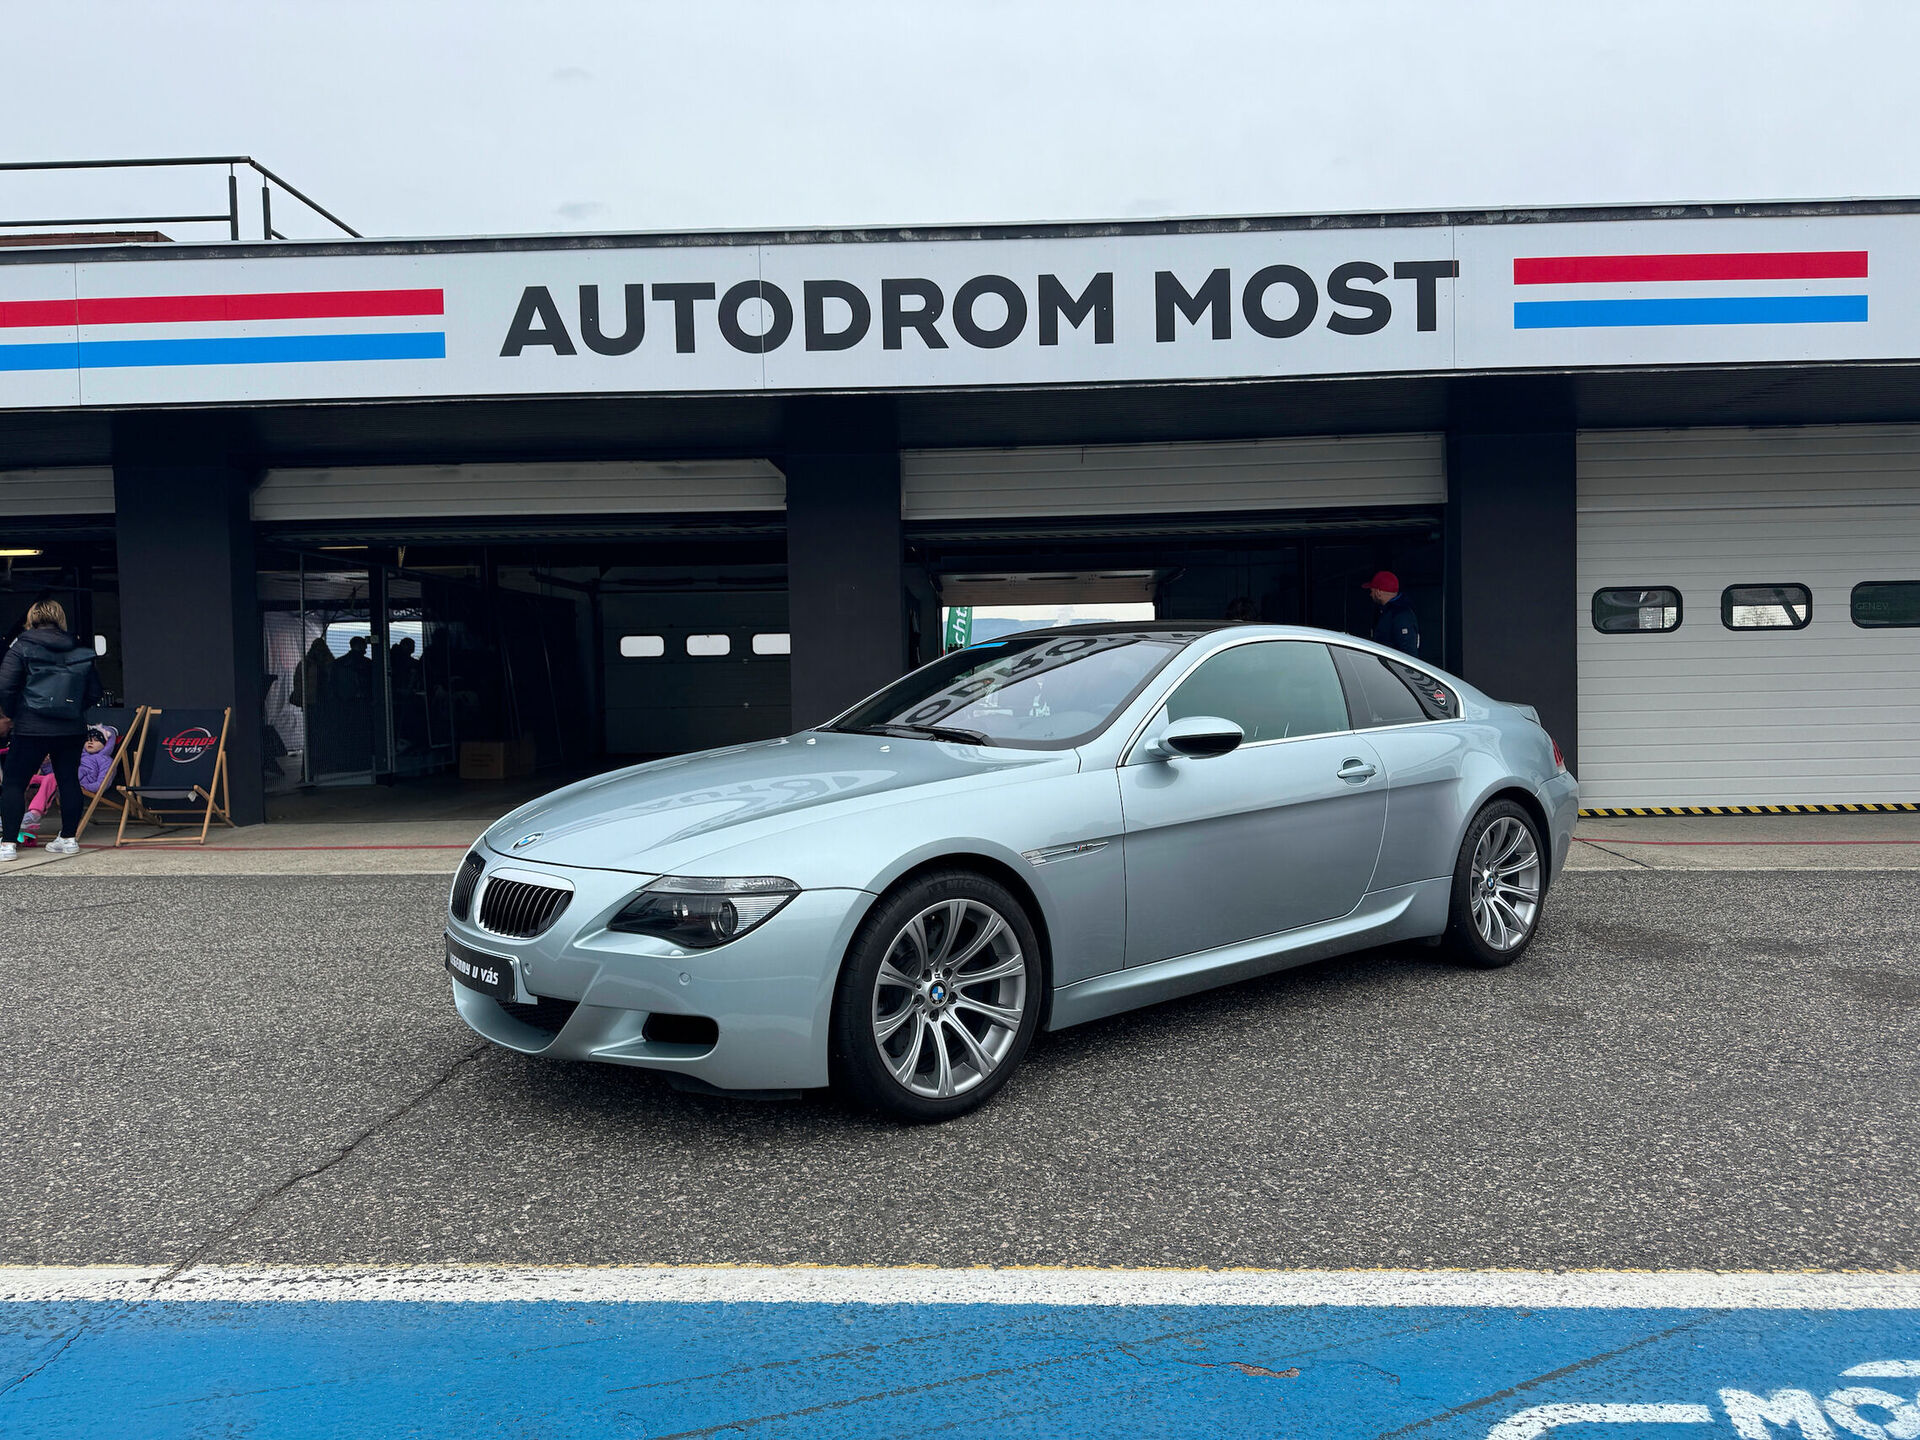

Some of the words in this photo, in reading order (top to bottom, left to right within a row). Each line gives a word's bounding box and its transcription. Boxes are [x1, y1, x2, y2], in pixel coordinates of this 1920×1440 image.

[500, 272, 1114, 357] AUTODROM
[1155, 259, 1460, 344] MOST
[161, 735, 218, 747] LEGENDY
[1717, 1386, 1920, 1440] MO
